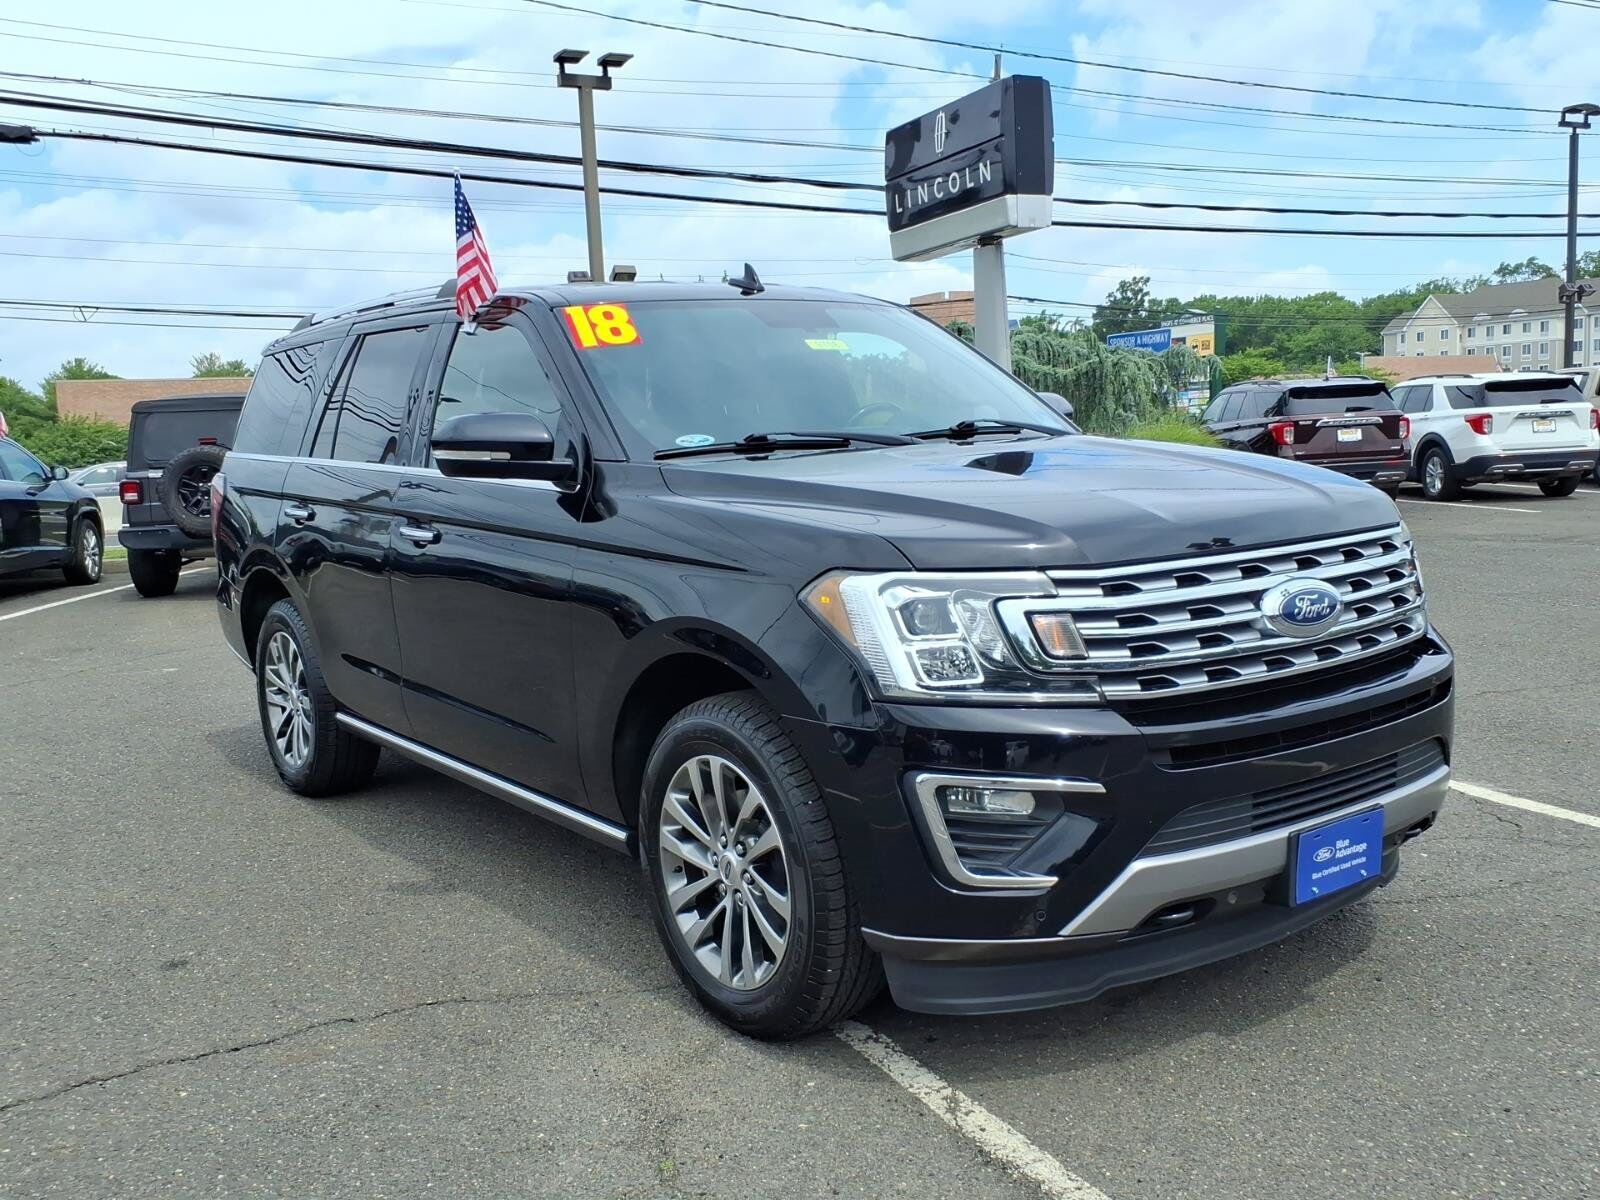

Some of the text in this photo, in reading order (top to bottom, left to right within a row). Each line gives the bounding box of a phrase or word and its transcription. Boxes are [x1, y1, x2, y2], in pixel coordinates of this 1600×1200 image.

[895, 160, 991, 213] LINCOLN
[564, 304, 638, 348] 18
[1109, 332, 1169, 347] SPONSOR A HIGHWAY
[1294, 594, 1330, 620] Ford
[1336, 839, 1350, 849] Blue
[1336, 843, 1367, 858] Advantage
